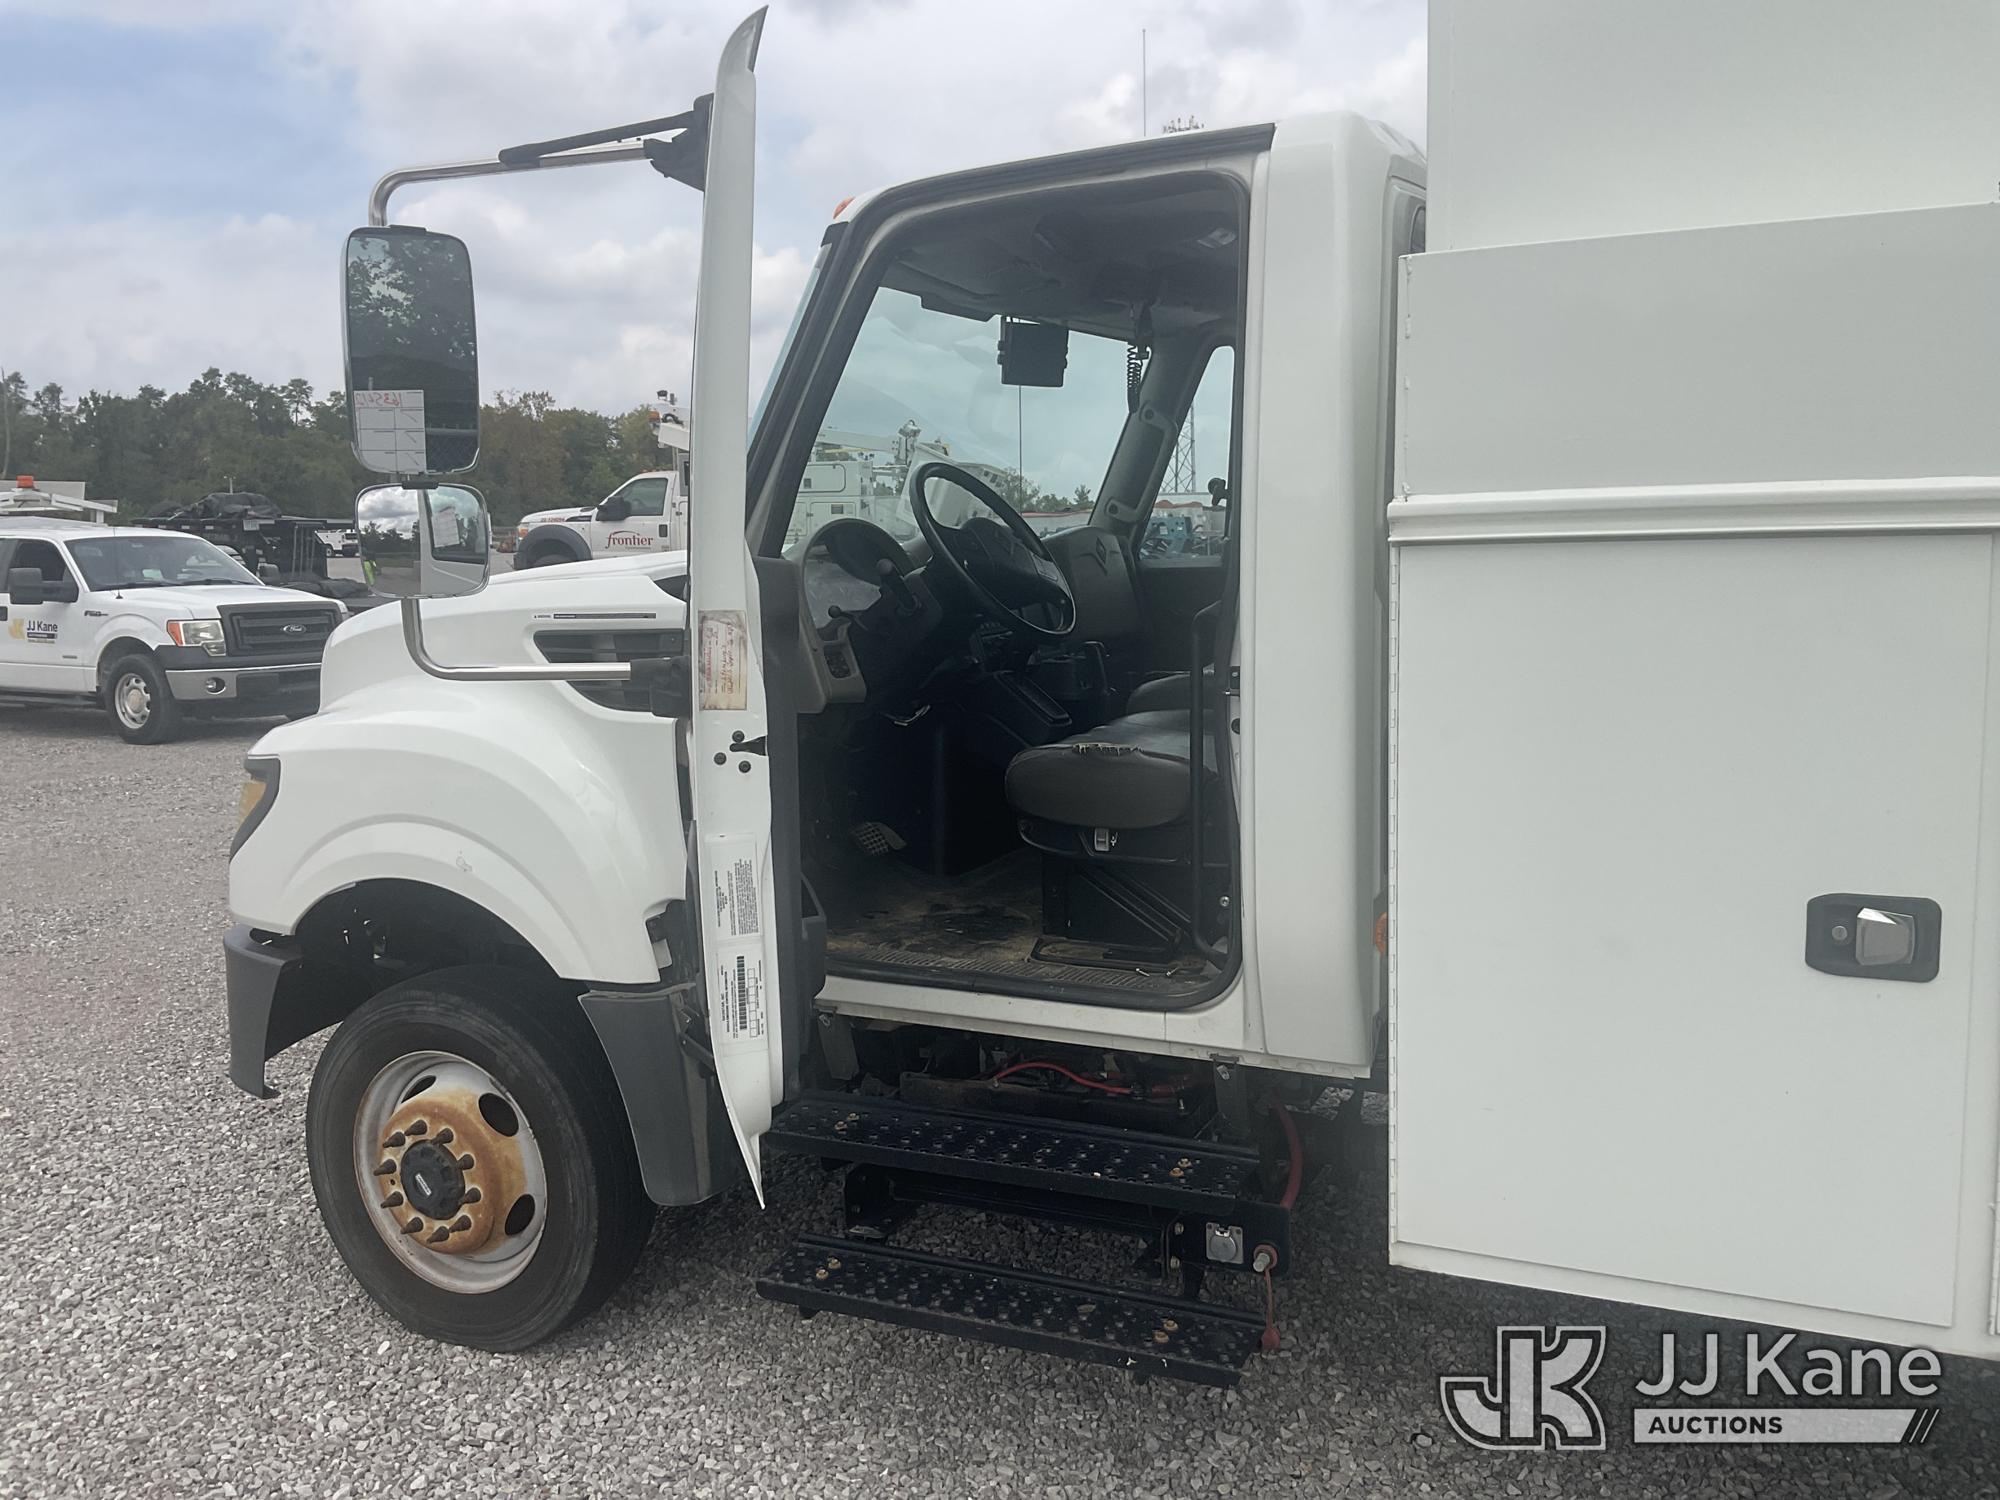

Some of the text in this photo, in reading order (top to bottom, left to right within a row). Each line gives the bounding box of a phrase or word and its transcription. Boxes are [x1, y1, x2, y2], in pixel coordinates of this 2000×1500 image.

[605, 532, 653, 549] frontier
[27, 620, 36, 631] JJ
[37, 620, 58, 632] Kane
